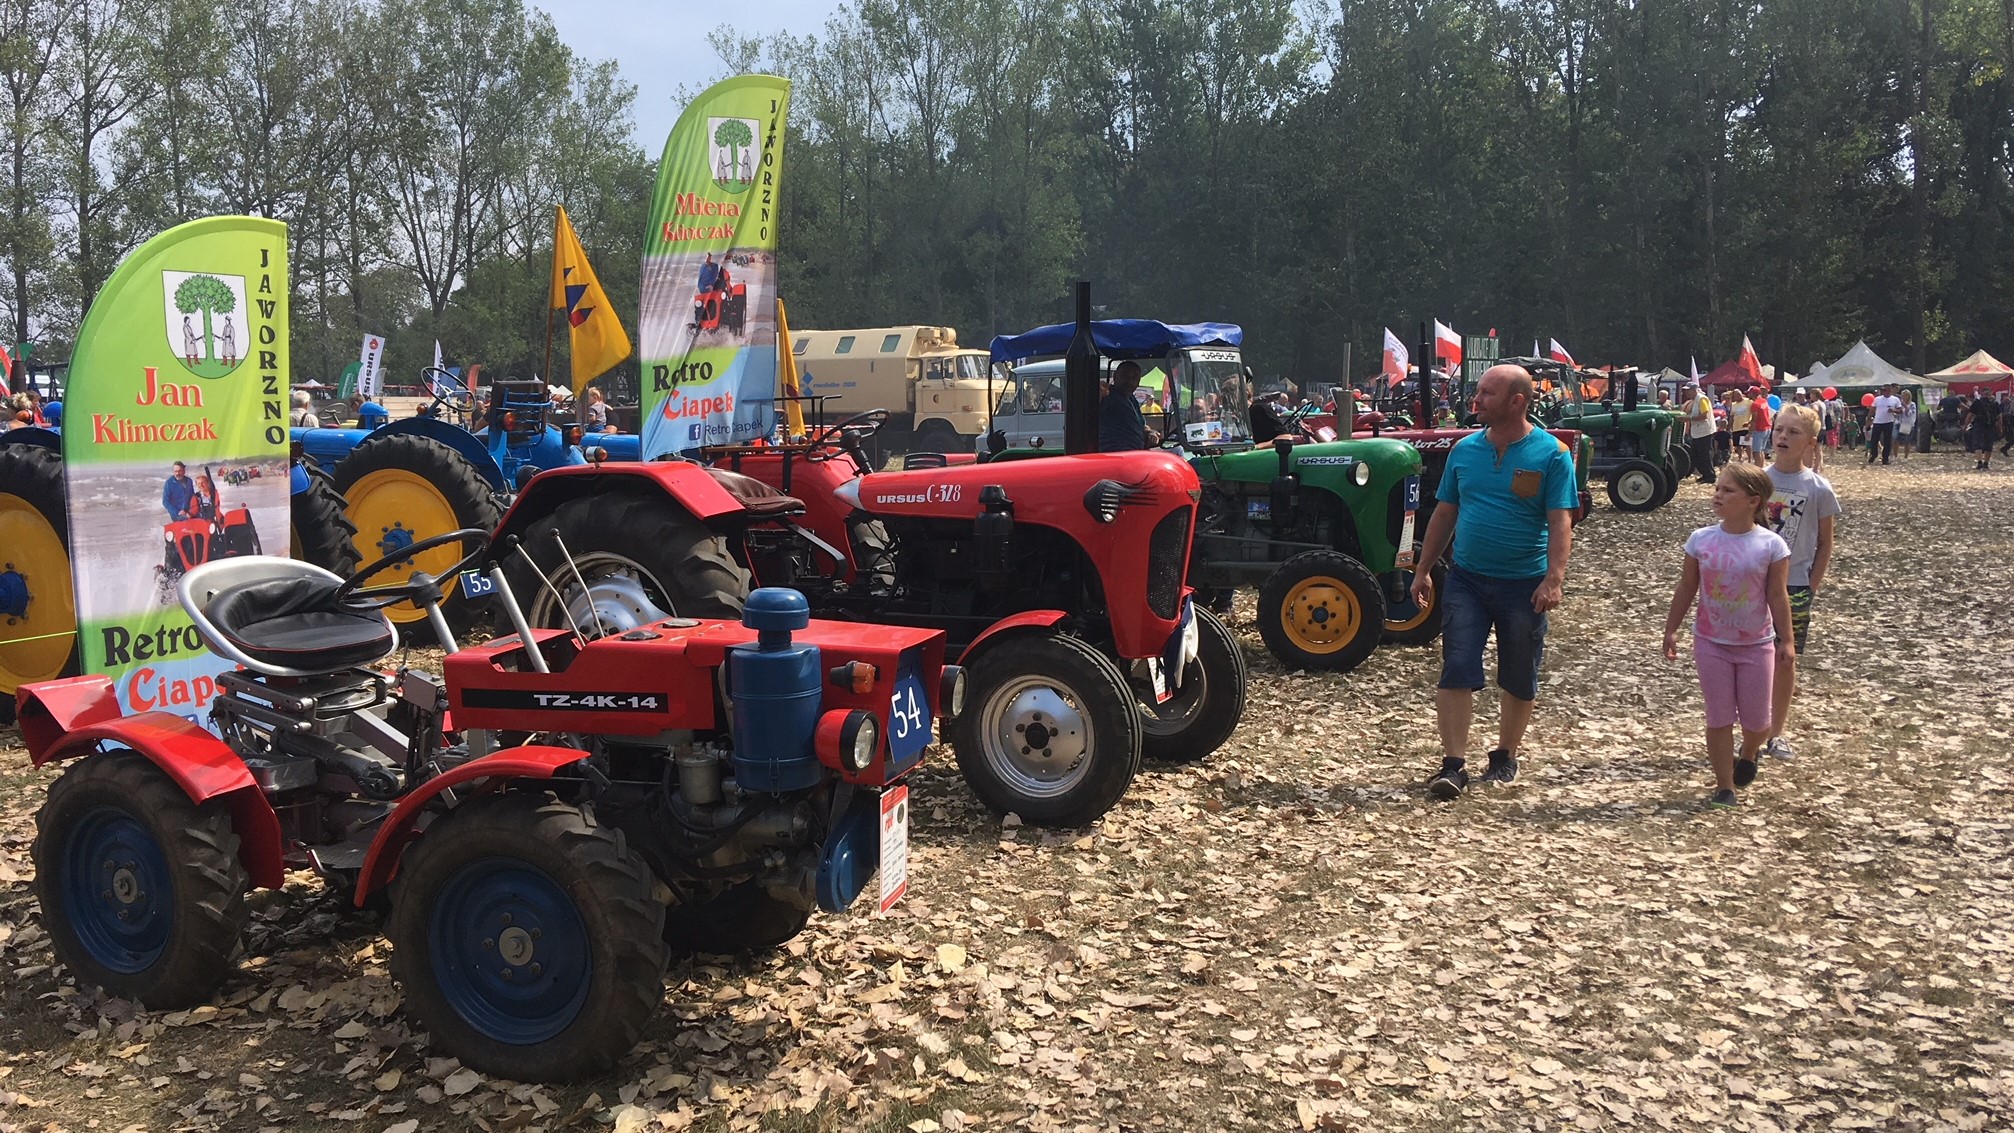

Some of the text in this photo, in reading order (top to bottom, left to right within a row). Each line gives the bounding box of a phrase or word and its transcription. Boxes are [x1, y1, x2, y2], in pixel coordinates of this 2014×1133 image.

[759, 99, 777, 241] JAWORZNO
[256, 248, 286, 446] JAWORZNO
[136, 366, 204, 407] Jan
[364, 352, 375, 396] URSUS
[653, 361, 713, 392] Retro
[664, 390, 734, 420] Ciapek
[92, 413, 218, 444] Klimczak
[1300, 457, 1349, 465] URSUS
[876, 484, 962, 504] URSUS C-328
[469, 572, 492, 593] 55
[102, 624, 204, 667] Retro
[128, 663, 244, 713] Ciap
[533, 694, 658, 709] TZ-4K-14
[891, 686, 921, 739] 54
